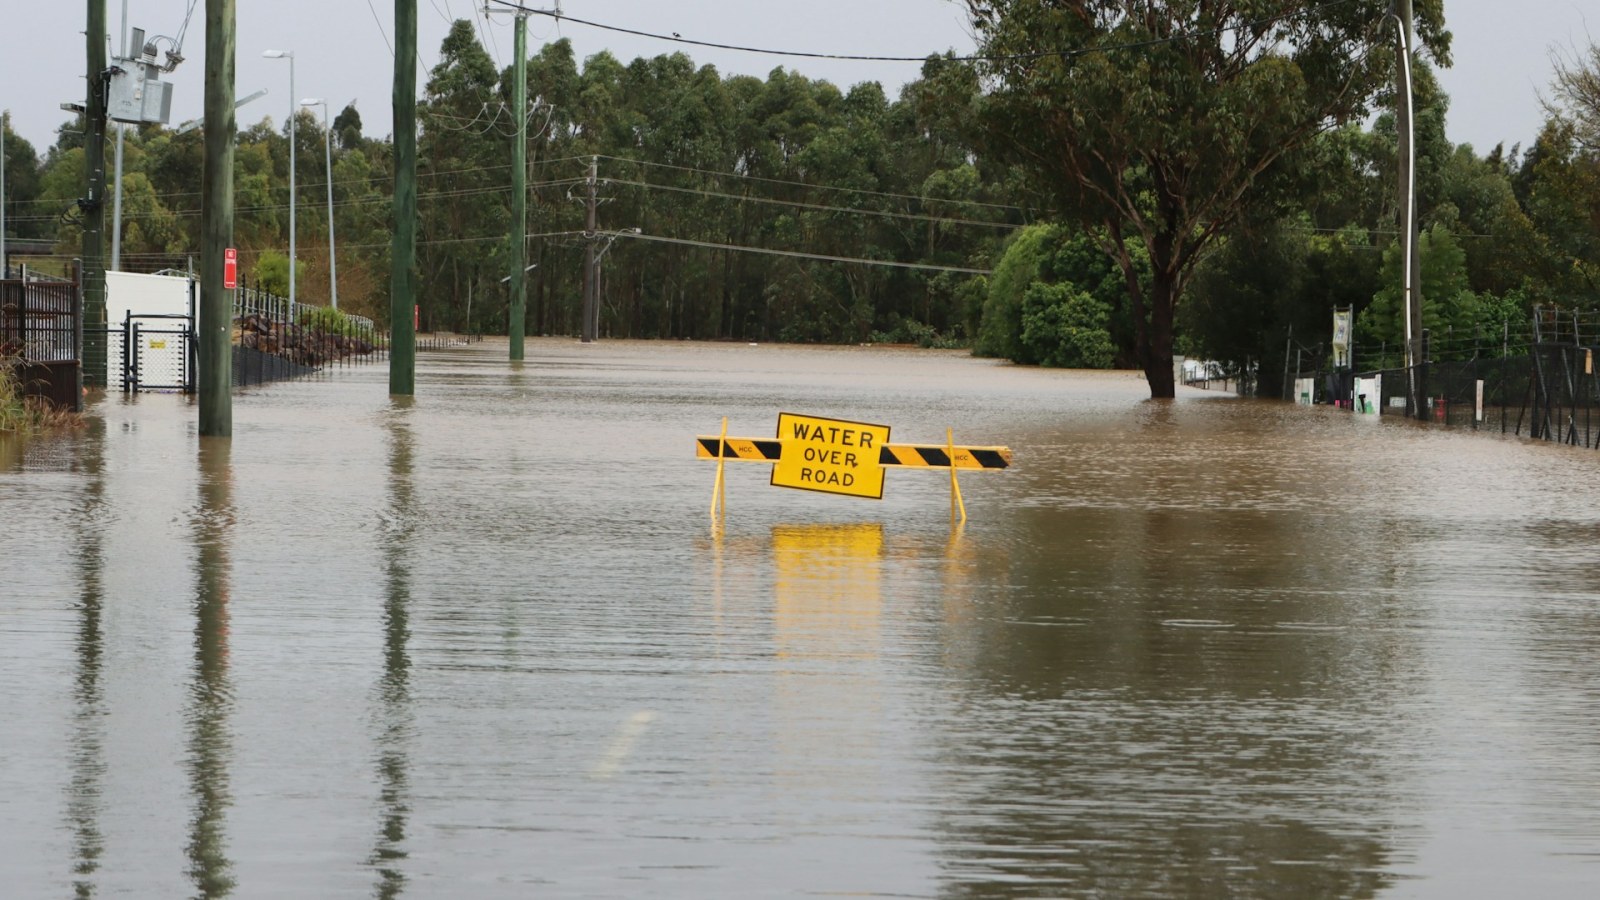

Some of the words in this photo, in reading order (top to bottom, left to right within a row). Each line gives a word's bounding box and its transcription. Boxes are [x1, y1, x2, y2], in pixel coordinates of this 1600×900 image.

[793, 422, 874, 449] WATER
[804, 447, 857, 467] OVER
[800, 468, 855, 487] ROAD
